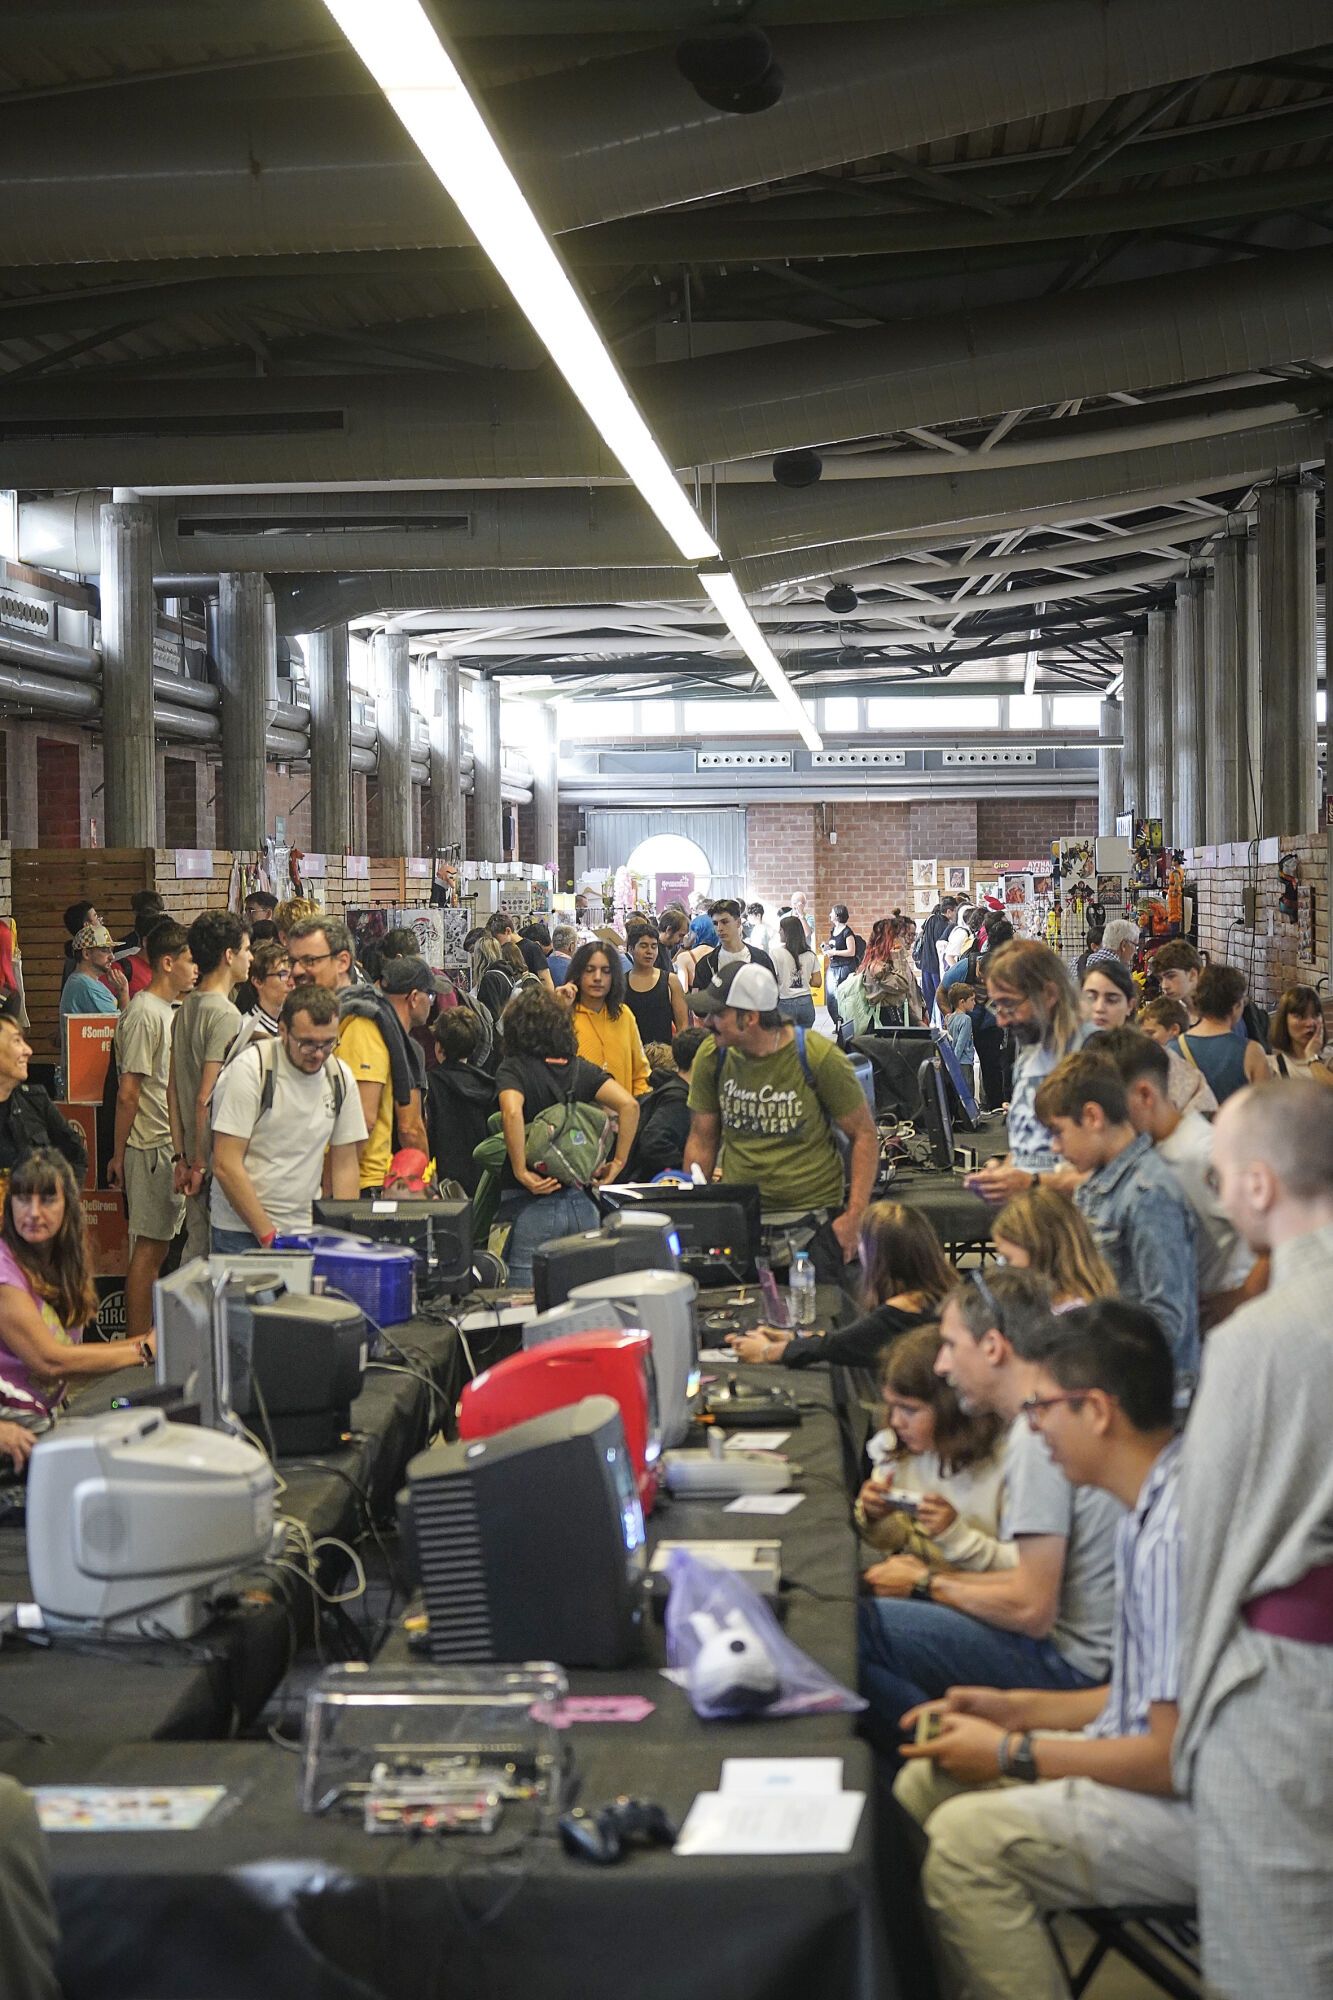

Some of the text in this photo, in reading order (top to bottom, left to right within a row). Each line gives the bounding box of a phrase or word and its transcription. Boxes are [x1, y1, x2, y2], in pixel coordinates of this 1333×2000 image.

[82, 1026, 115, 1038] #SomDe
[101, 1041, 111, 1052] #E
[96, 1308, 127, 1325] GIRO
